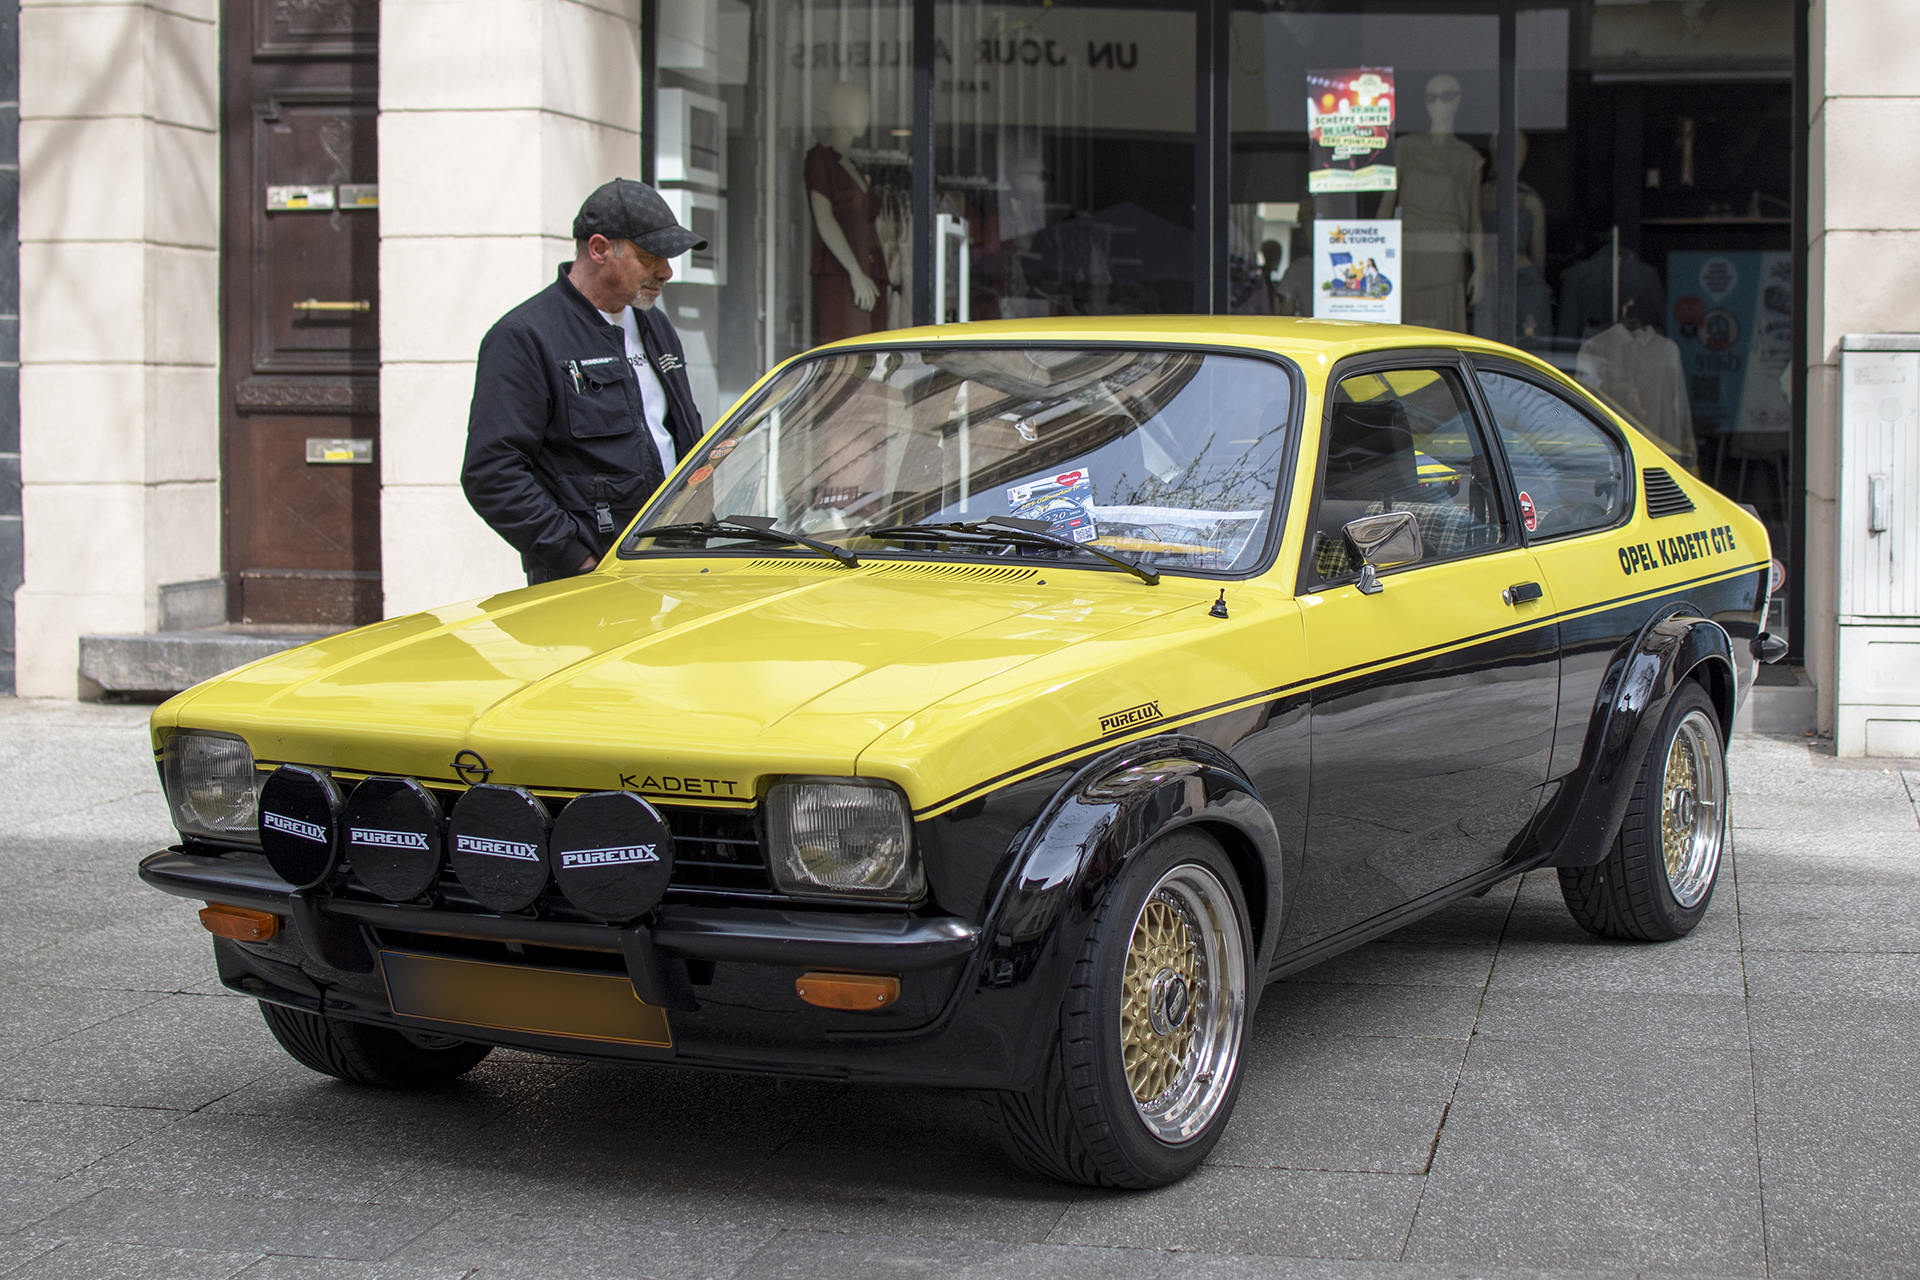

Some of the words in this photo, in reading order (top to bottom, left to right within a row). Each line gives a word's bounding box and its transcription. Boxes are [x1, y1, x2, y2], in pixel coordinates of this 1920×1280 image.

[1329, 236, 1341, 244] DE
[1343, 236, 1386, 244] L'EUROPE
[1338, 227, 1378, 235] JOURNÉE
[1618, 542, 1659, 576] OPEL
[1657, 530, 1711, 567] KADETT
[1710, 525, 1736, 554] GTE
[1100, 700, 1163, 732] PURELUX
[619, 773, 738, 795] KADETT
[264, 813, 327, 843] PURELUX
[351, 828, 429, 850] PURELUX
[457, 837, 539, 861] PURELUX
[562, 844, 659, 866] PURELUX
